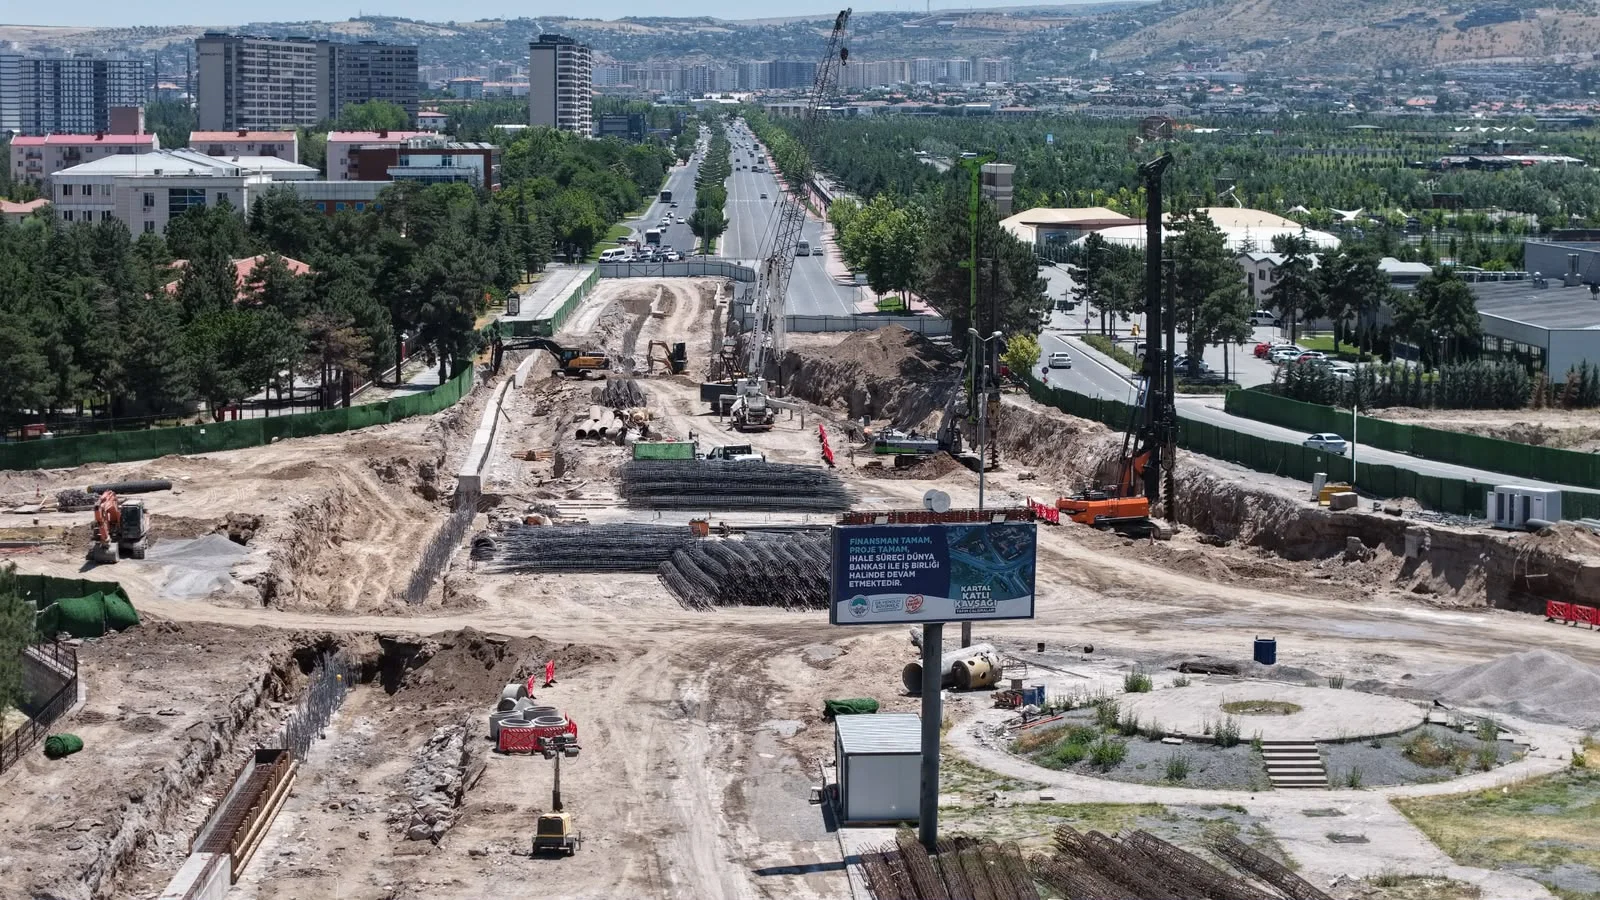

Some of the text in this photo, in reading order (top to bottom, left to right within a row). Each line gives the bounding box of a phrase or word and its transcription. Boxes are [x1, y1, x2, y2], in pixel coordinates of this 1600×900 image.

[849, 536, 932, 545] FİNANSMAN TAMAM,
[879, 545, 910, 553] TAMAM,
[849, 551, 935, 562] İHALE SÜRECİ DÜNYA
[849, 560, 940, 571] BANKASI İLE İŞ BİRLİĞİ
[849, 570, 916, 579] HALİNDE DEVAM
[849, 579, 902, 588] ETMEKTEDİR.
[962, 591, 990, 600] KATLI
